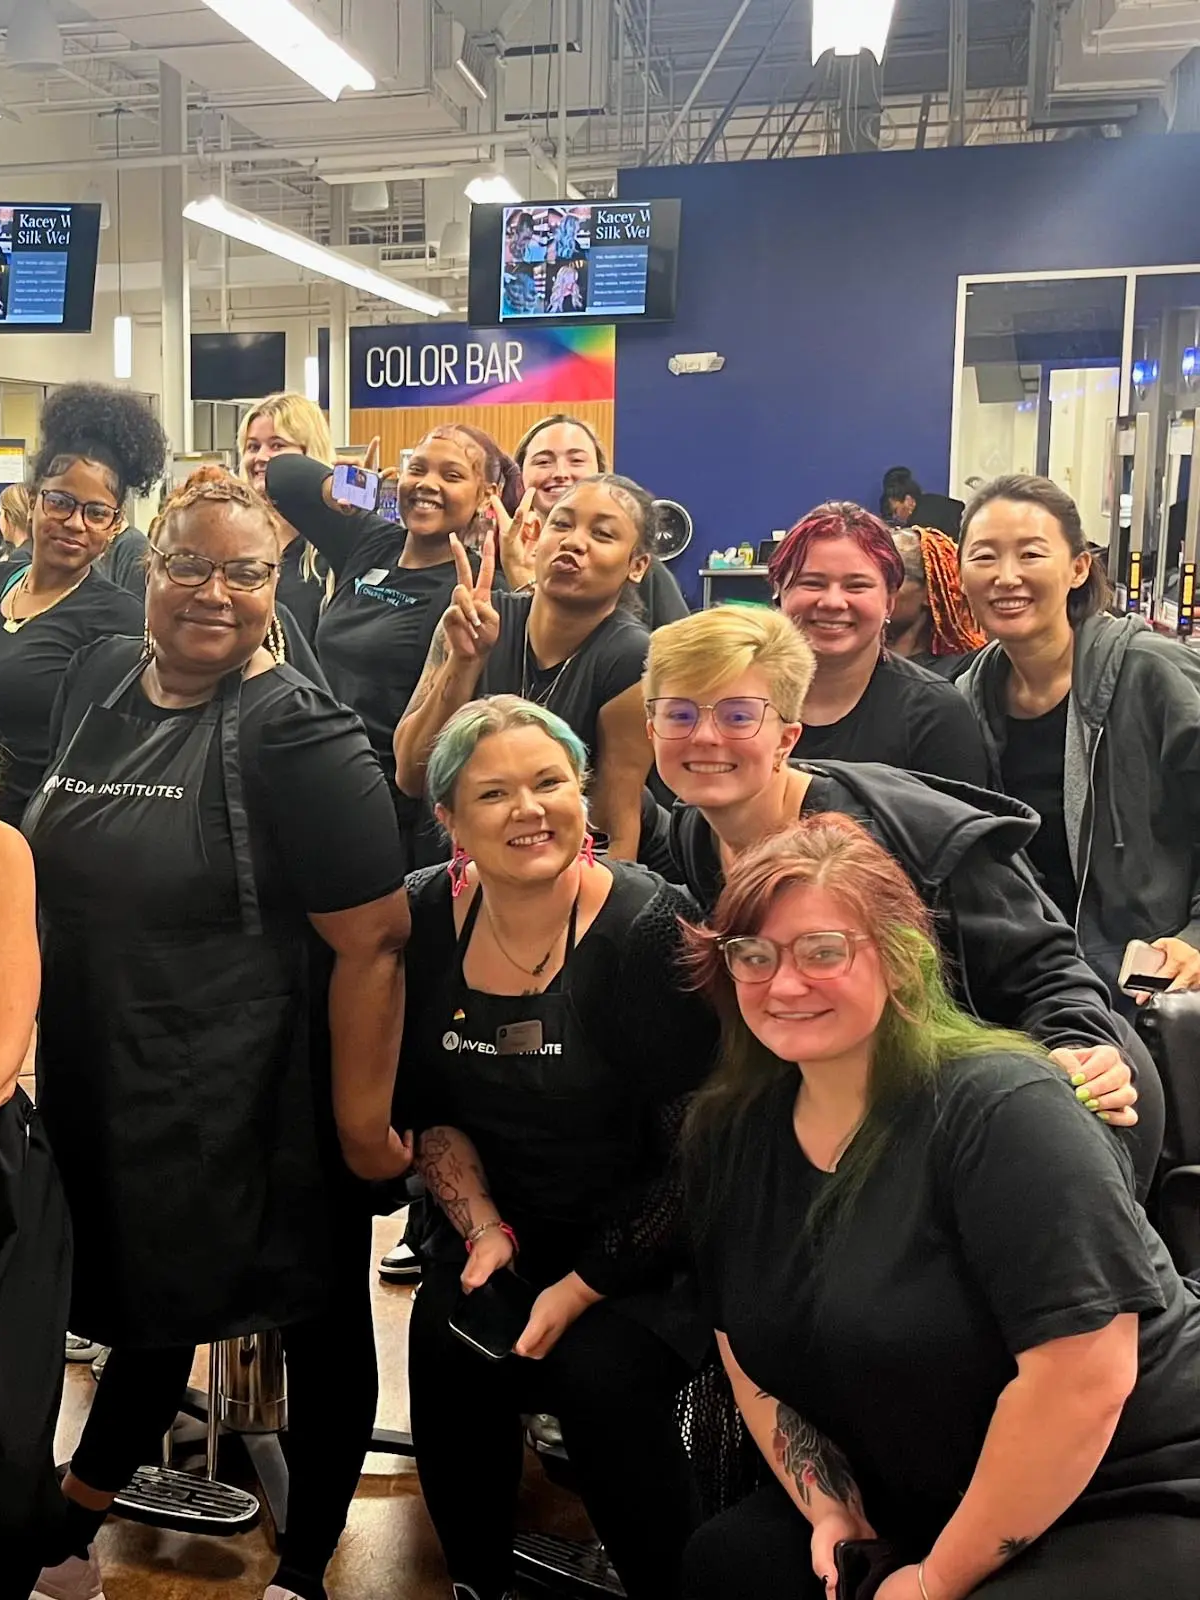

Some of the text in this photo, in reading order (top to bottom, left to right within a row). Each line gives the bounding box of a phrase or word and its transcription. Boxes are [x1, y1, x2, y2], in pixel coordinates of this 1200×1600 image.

[19, 214, 57, 232] Kacey
[597, 211, 636, 229] Kacey
[17, 231, 42, 245] Silk
[595, 225, 621, 240] Silk
[365, 341, 523, 388] COLOR BAR
[97, 782, 185, 800] INSTITUTES
[461, 1039, 498, 1056] AVED
